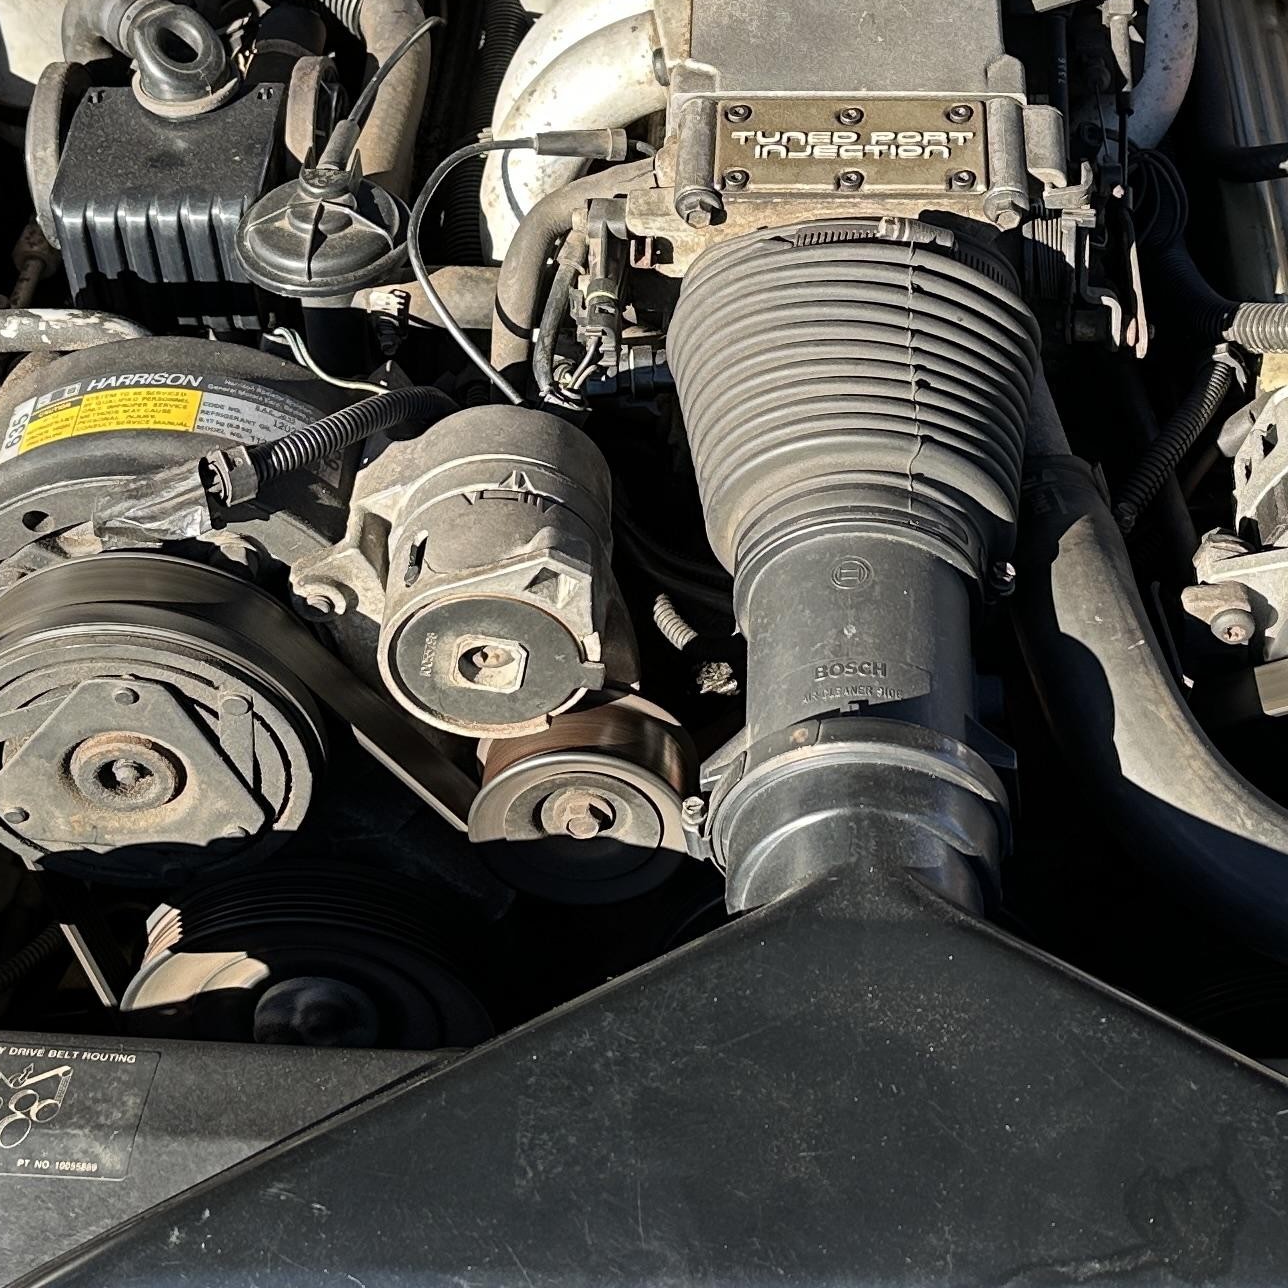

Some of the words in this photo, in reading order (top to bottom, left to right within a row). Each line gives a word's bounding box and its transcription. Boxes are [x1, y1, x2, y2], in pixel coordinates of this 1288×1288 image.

[731, 131, 860, 146] TUNED
[870, 131, 975, 146] PORT
[754, 145, 951, 160] INJECTION
[86, 371, 203, 391] HARRISON
[814, 661, 887, 682] BOSCH
[802, 691, 820, 704] AIR
[822, 684, 874, 701] CLEANER
[9, 1046, 45, 1057] DRIVE
[48, 1049, 78, 1059] BELT
[82, 1051, 137, 1064] ROUTING
[17, 1158, 30, 1167] PT
[34, 1159, 50, 1170] NO
